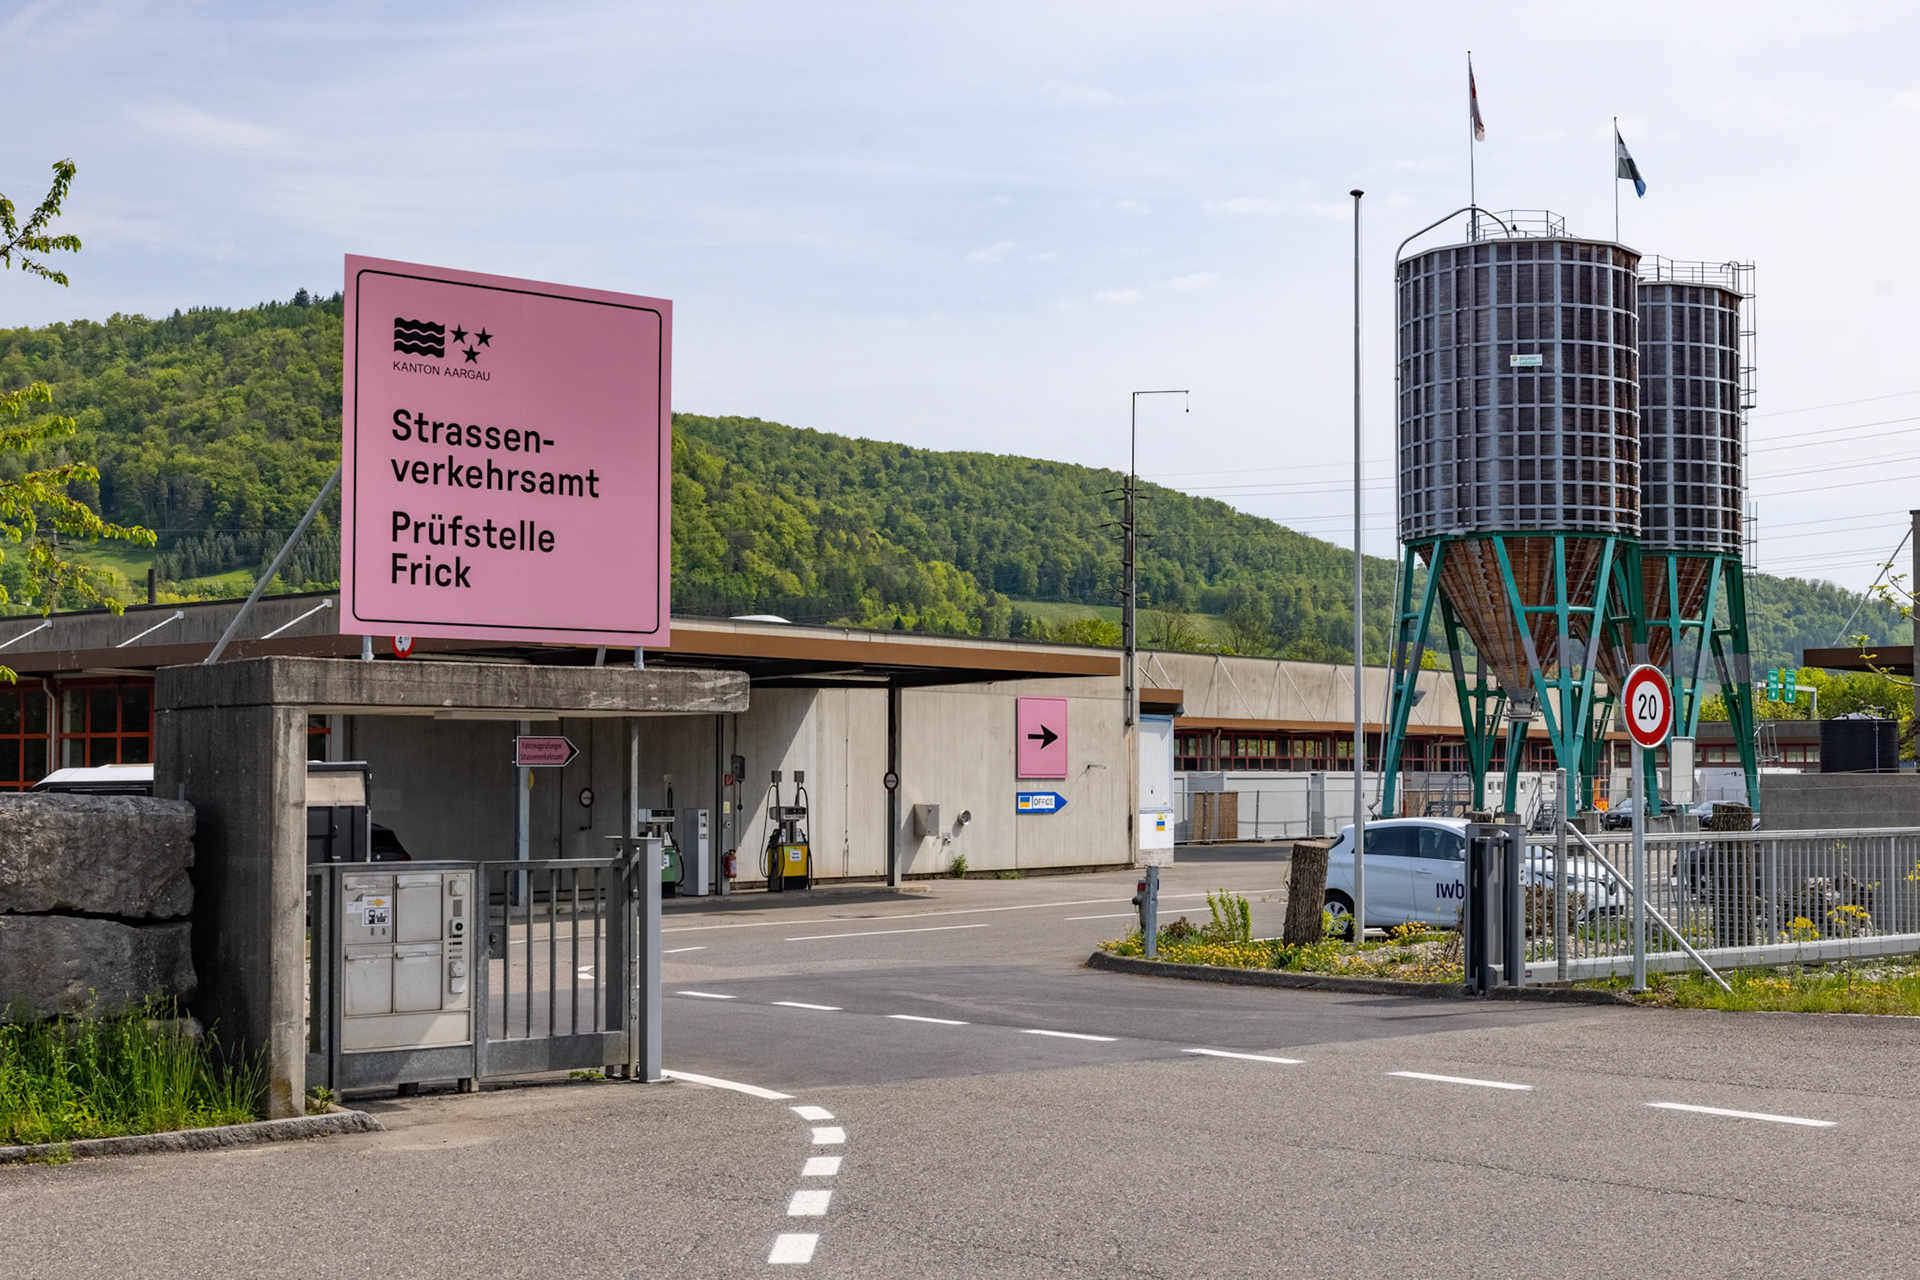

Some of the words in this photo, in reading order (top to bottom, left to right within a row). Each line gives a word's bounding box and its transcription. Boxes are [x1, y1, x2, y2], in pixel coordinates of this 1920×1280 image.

[392, 361, 441, 376] KANTON
[444, 366, 491, 382] AARGAU
[392, 409, 555, 453] Strassen-
[391, 455, 600, 498] verkehrsamt
[392, 511, 556, 553] Prüfstelle
[391, 553, 472, 588] Frick
[1638, 694, 1657, 720] 20
[1033, 798, 1054, 806] OFFICE
